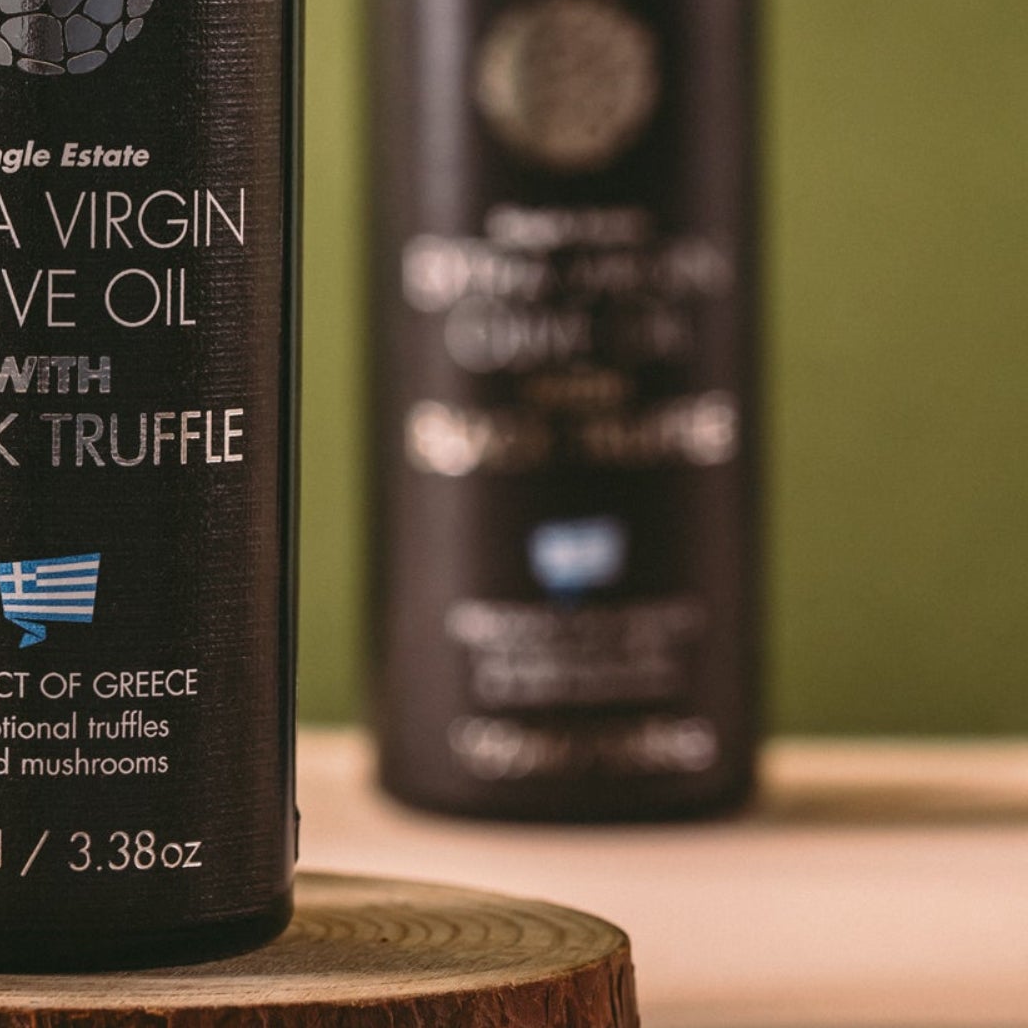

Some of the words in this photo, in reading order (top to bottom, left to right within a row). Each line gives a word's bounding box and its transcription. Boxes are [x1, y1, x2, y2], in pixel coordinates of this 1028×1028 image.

[60, 142, 151, 168] Estate
[45, 187, 246, 250] VIRGIN
[104, 267, 197, 328] OIL
[39, 408, 245, 468] TRUFFLE
[40, 672, 82, 699] OF
[93, 668, 199, 699] GREECE
[88, 710, 170, 740] truffles
[21, 748, 170, 776] mushrooms
[20, 830, 51, 877] /
[68, 830, 203, 872] 3.38oz
